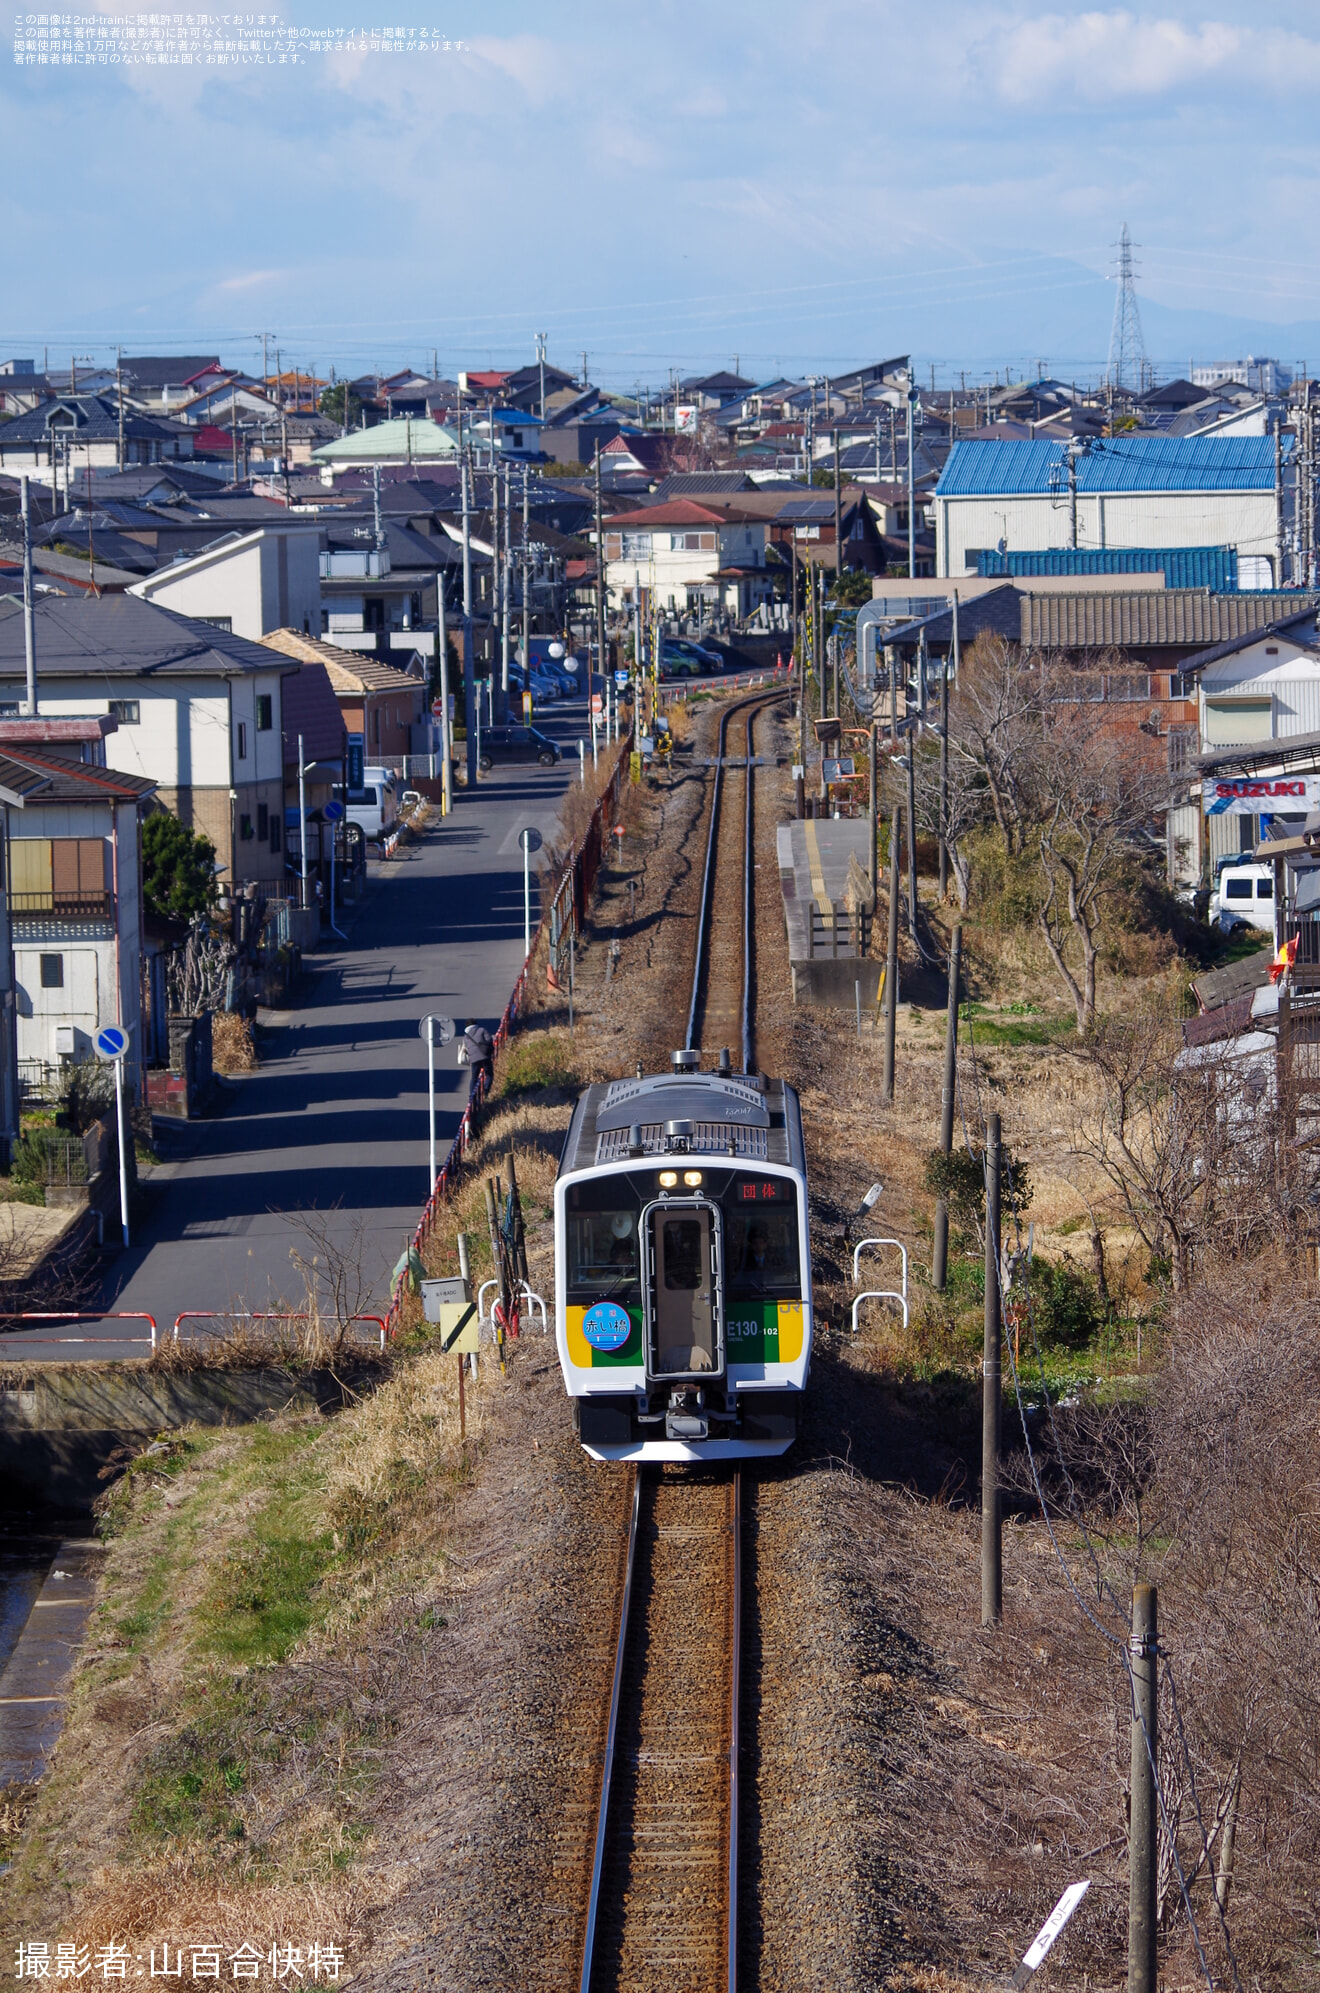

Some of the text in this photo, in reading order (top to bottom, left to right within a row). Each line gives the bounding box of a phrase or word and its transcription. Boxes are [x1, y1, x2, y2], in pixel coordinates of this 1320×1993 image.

[1216, 781, 1306, 798] SUZUKI
[743, 1183, 776, 1199] 団体
[779, 1301, 801, 1314] JR
[585, 1319, 628, 1333] 赤い橋
[1036, 1933, 1051, 1949] 4
